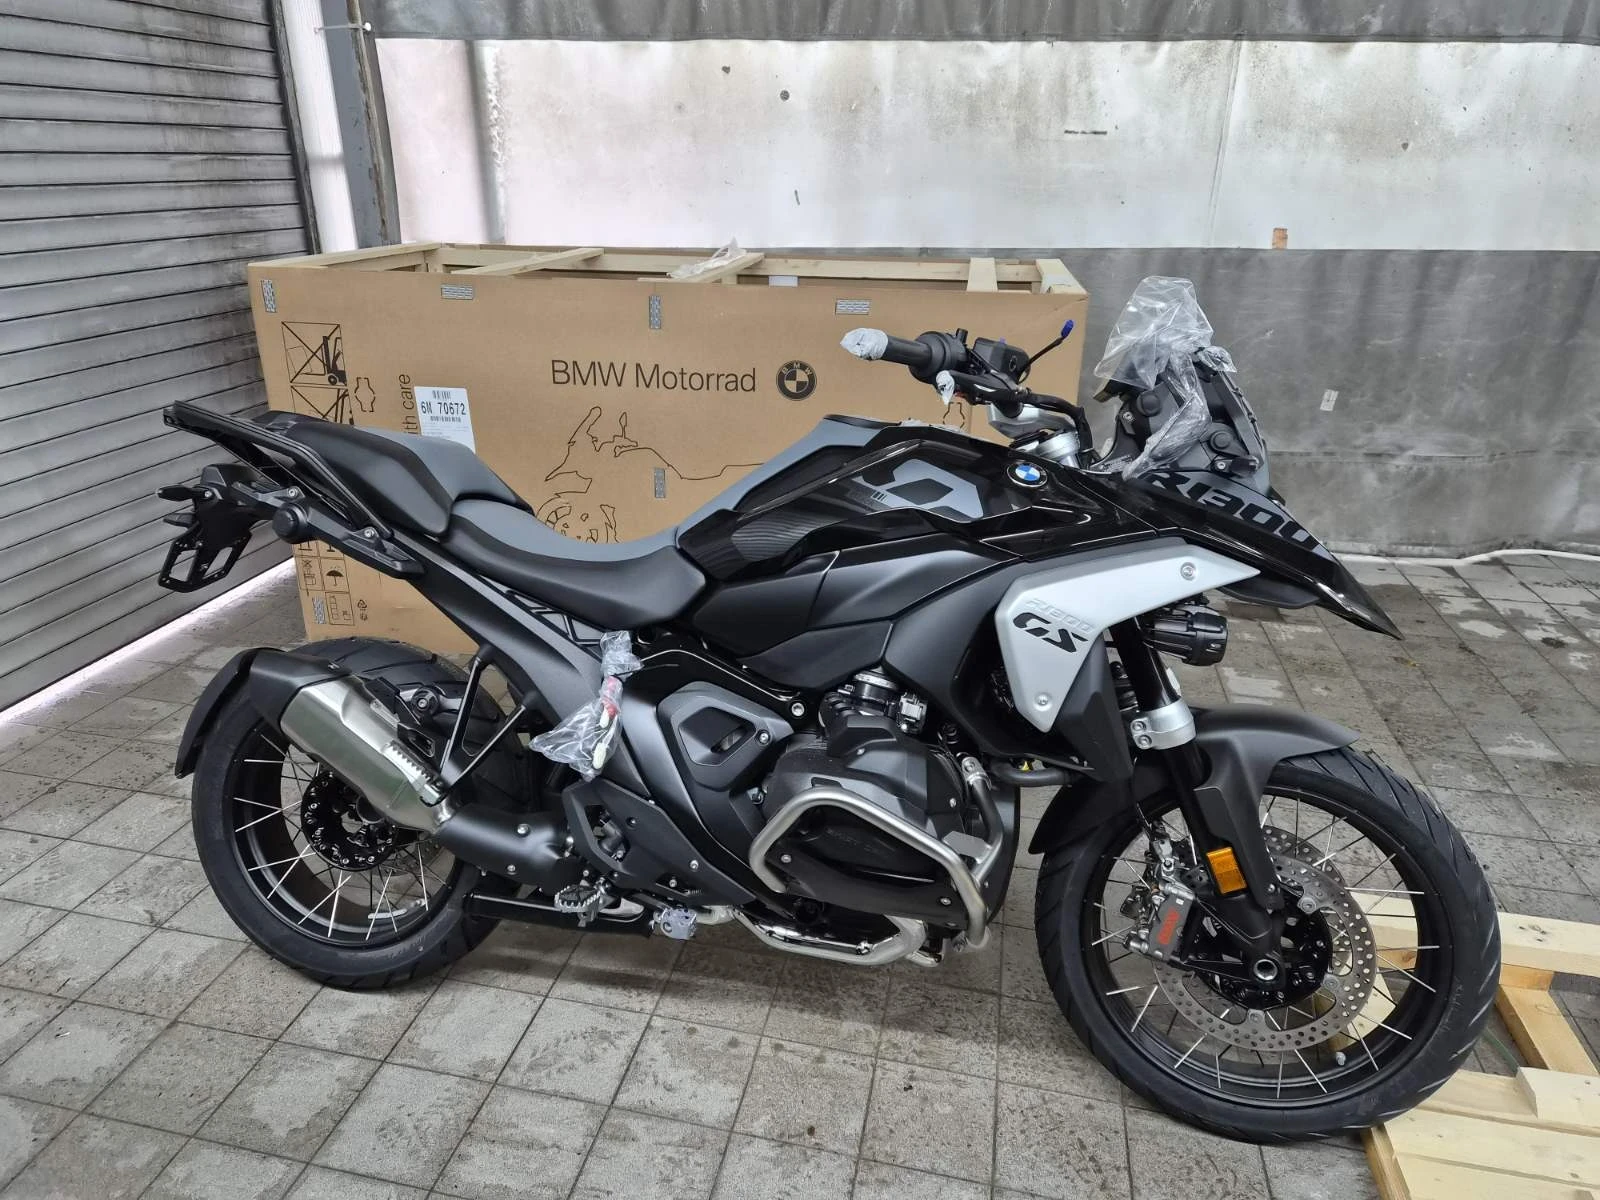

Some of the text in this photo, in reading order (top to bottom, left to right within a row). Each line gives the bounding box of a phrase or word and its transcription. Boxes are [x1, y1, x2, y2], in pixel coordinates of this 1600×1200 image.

[551, 359, 756, 392] BMW Motorrad
[399, 374, 418, 435] ith care
[438, 402, 466, 416] 70672
[1013, 612, 1089, 653] GS
